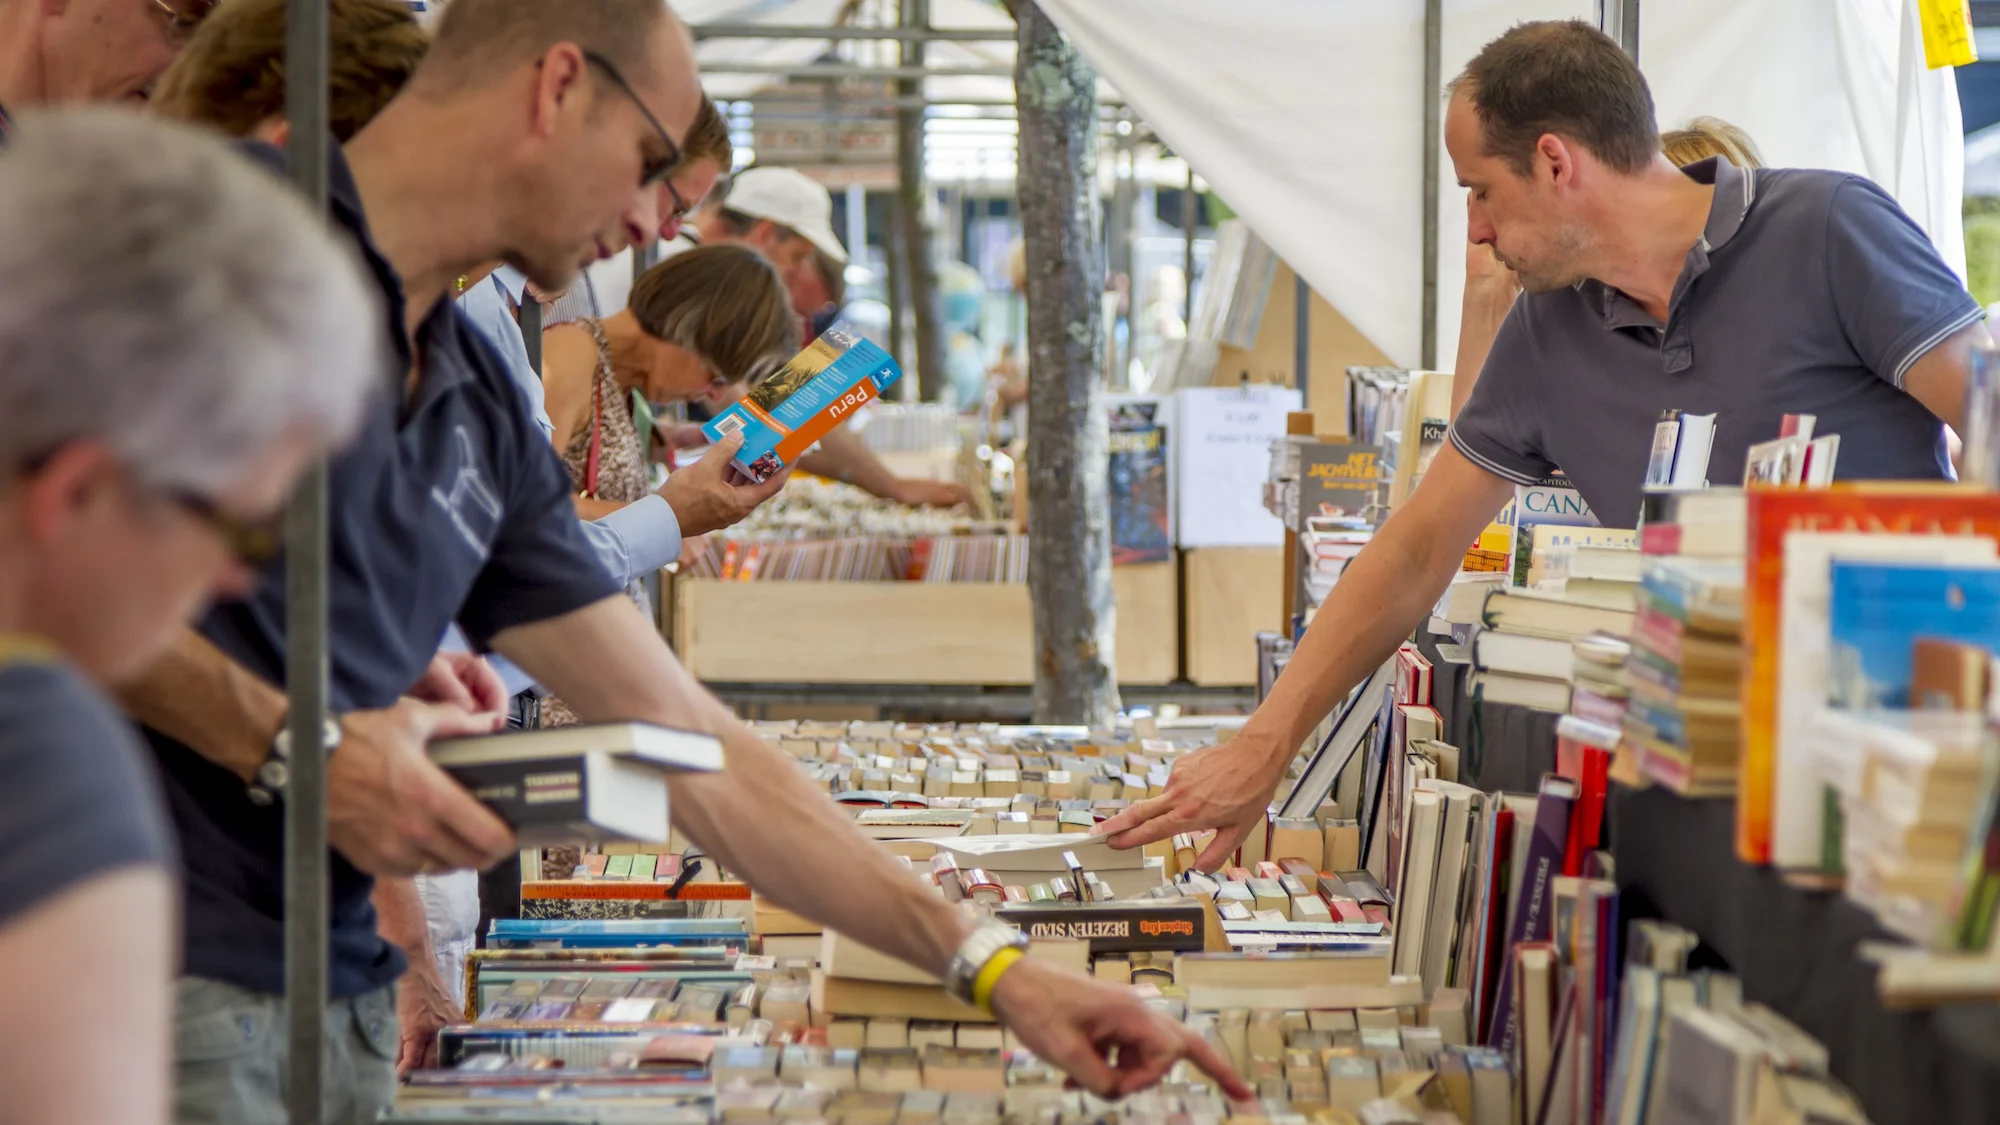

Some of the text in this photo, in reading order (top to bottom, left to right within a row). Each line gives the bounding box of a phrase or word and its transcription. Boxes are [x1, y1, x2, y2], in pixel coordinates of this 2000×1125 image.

[829, 385, 868, 418] Peru
[1537, 478, 1576, 488] CAPITOO
[1031, 920, 1130, 938] BEZETEN STAD
[1140, 920, 1193, 936] Stephen King
